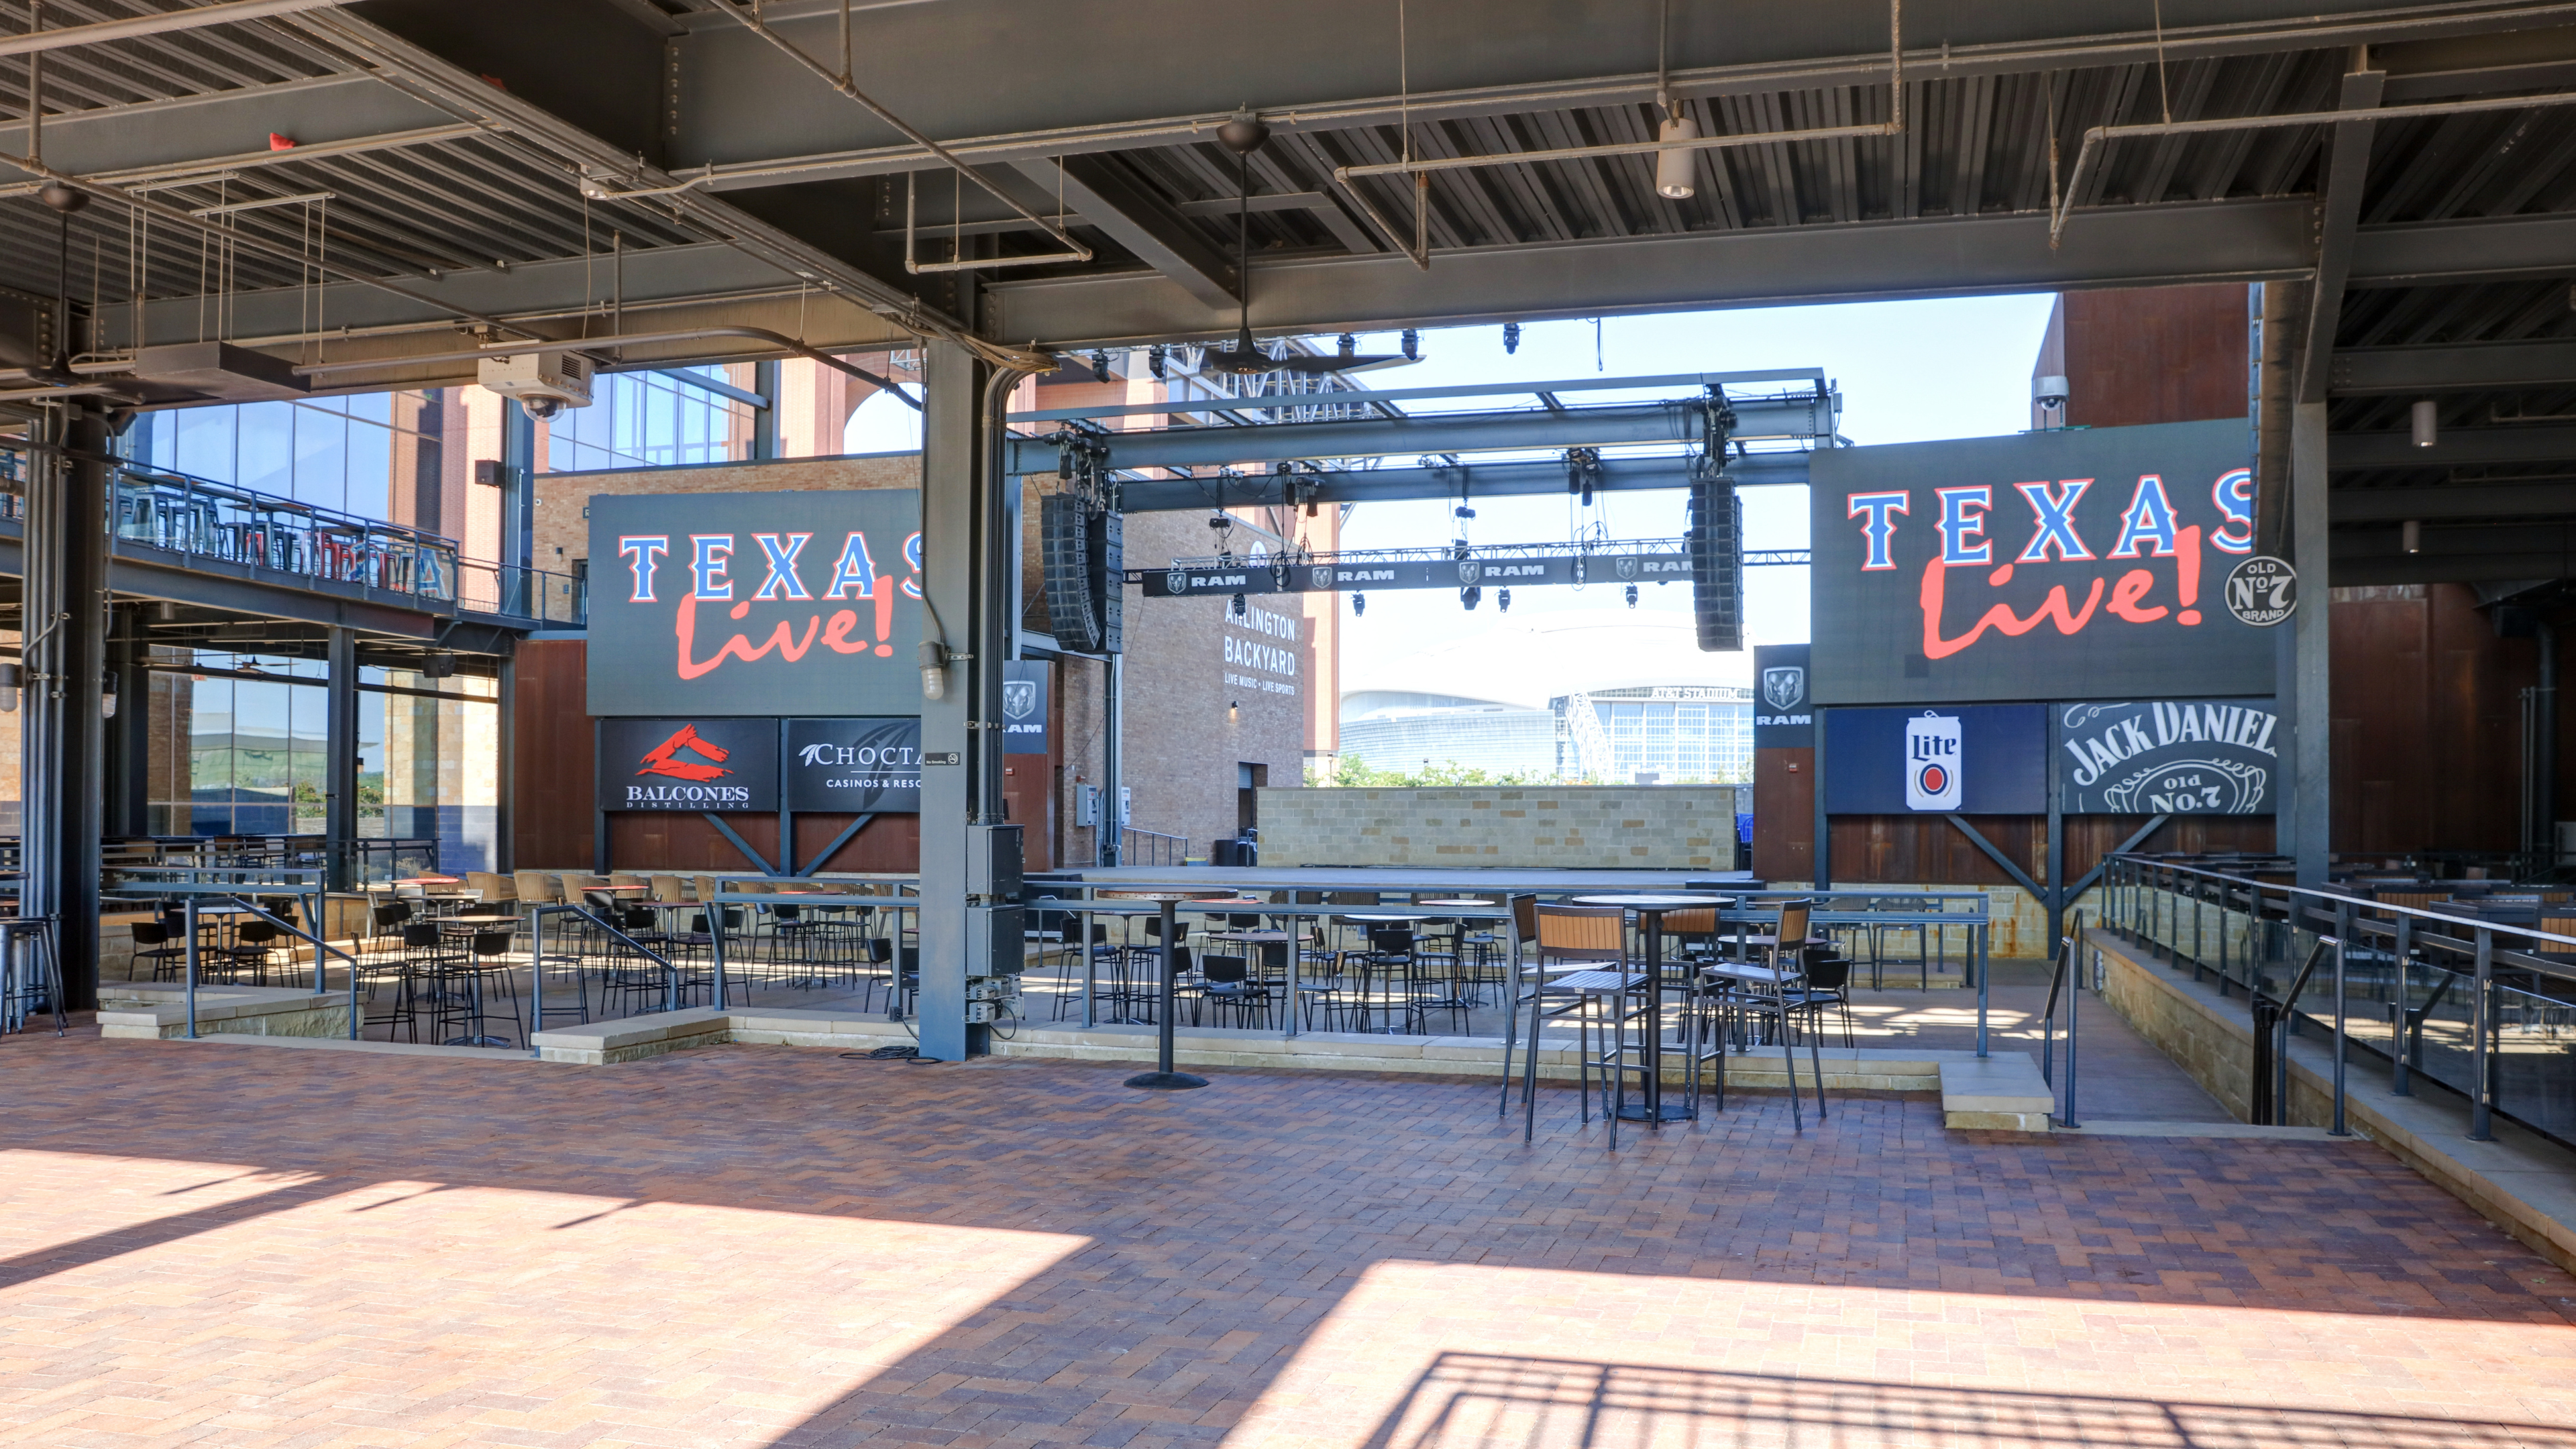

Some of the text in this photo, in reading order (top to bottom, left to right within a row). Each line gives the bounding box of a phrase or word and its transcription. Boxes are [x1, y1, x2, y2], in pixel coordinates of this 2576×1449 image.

[1847, 468, 2252, 572] TEXAS
[1485, 565, 1544, 577] RAM
[2247, 561, 2277, 574] OLD
[1191, 575, 1246, 587] RAM
[1337, 570, 1395, 582] RAM
[1920, 525, 2202, 659] Live!
[2242, 609, 2284, 623] BRAND
[675, 576, 893, 680] Live!
[1224, 635, 1295, 676] BACKYARD
[1224, 672, 1238, 686] LIVE
[1239, 675, 1257, 689] MUSIC
[1262, 680, 1275, 693] LIVE
[1275, 682, 1295, 696] SPORTS
[1651, 687, 1741, 700] AT&T STADIUM
[1756, 714, 1811, 726] RAM
[1003, 724, 1042, 733] AM
[1911, 735, 1957, 761] Lite
[2065, 714, 2156, 786] JACK
[826, 779, 879, 788] CASINOS
[882, 780, 890, 788] &
[626, 786, 749, 802] BALCONES
